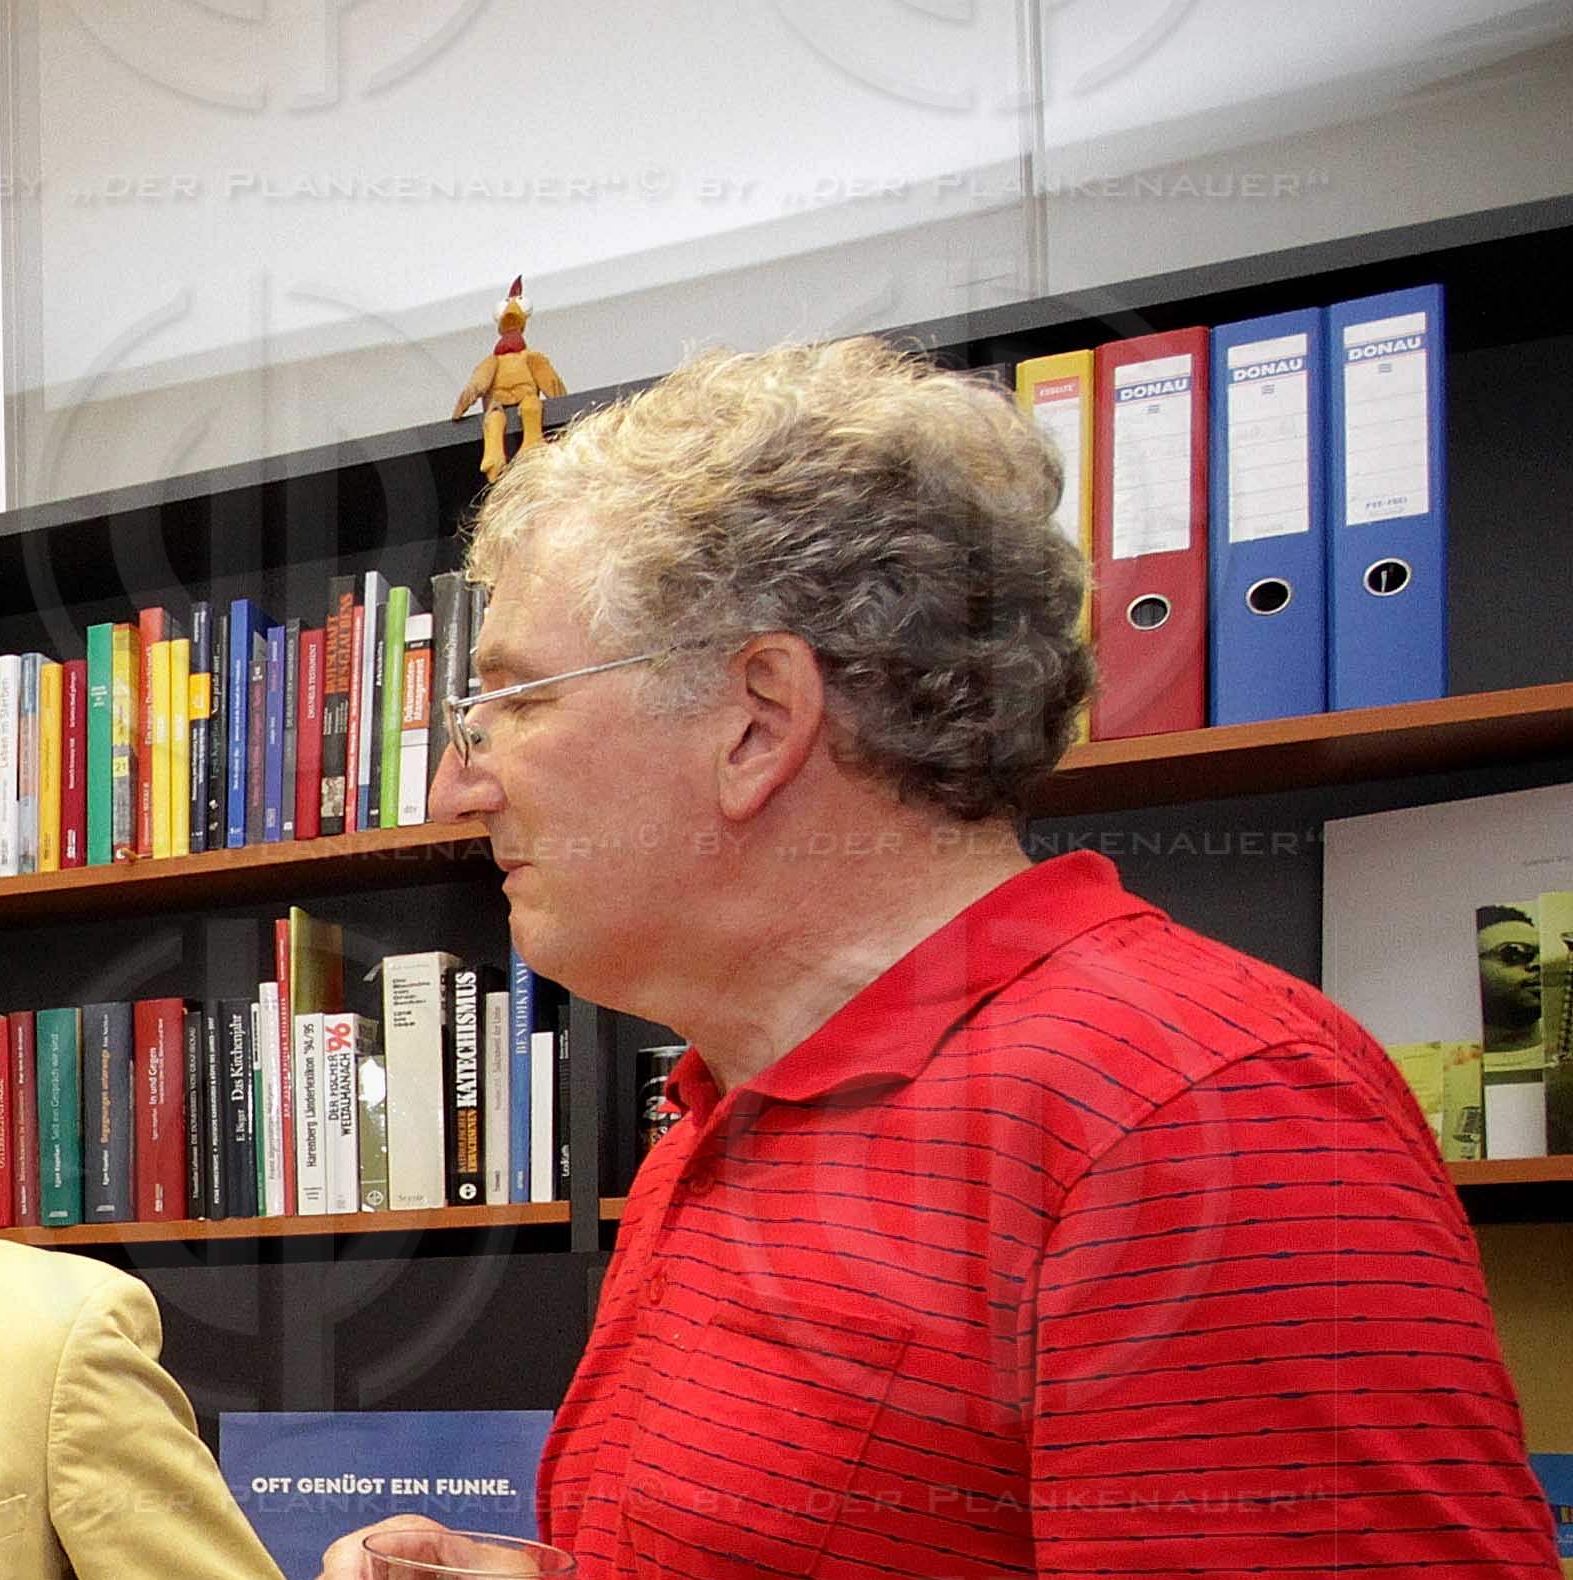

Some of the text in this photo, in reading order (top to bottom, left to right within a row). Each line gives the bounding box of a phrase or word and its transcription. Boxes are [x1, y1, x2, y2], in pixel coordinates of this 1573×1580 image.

[1233, 357, 1305, 382] DONAU
[1348, 335, 1422, 363] DONAU
[1120, 377, 1189, 401] DONAU
[326, 615, 338, 693] BOTSCHAFT
[455, 971, 477, 1108] KATECHISMUS
[516, 987, 527, 1054] BENEDIKT
[148, 1048, 159, 1076] Gegen
[230, 1014, 246, 1101] Das Kirchenjahr
[149, 1077, 157, 1095] und
[304, 1057, 317, 1118] Länderlexikon
[327, 1055, 339, 1121] DER FISCHER
[340, 1052, 352, 1136] WELTALMANACH
[305, 1121, 317, 1168] Harenberg
[252, 1474, 517, 1495] OFT GENÜGT EIN FUNKE.
